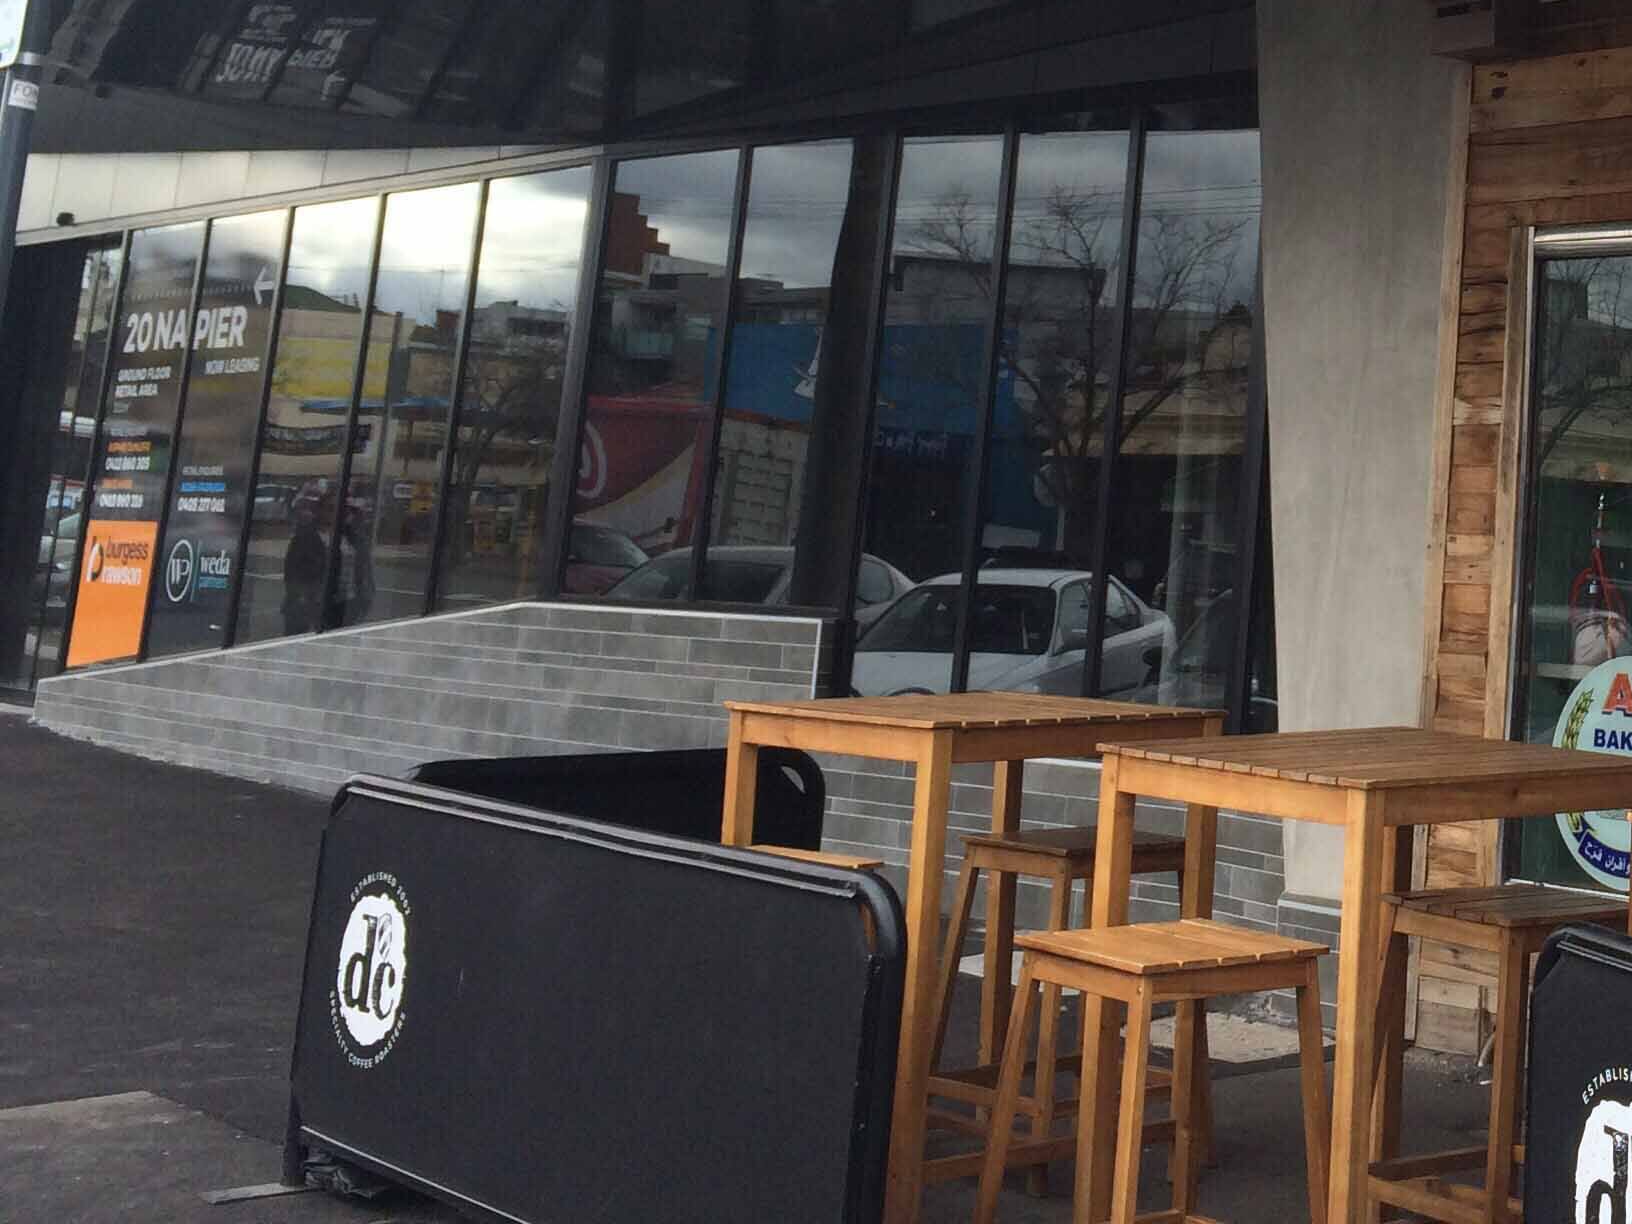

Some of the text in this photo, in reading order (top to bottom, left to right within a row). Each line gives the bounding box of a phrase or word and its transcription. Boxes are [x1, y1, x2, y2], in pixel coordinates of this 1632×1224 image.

[123, 305, 248, 353] 20 NAPIER
[106, 536, 149, 566] burgess
[200, 549, 231, 575] weda
[350, 871, 397, 902] ESTABLISHED
[348, 1051, 374, 1069] COFFEE
